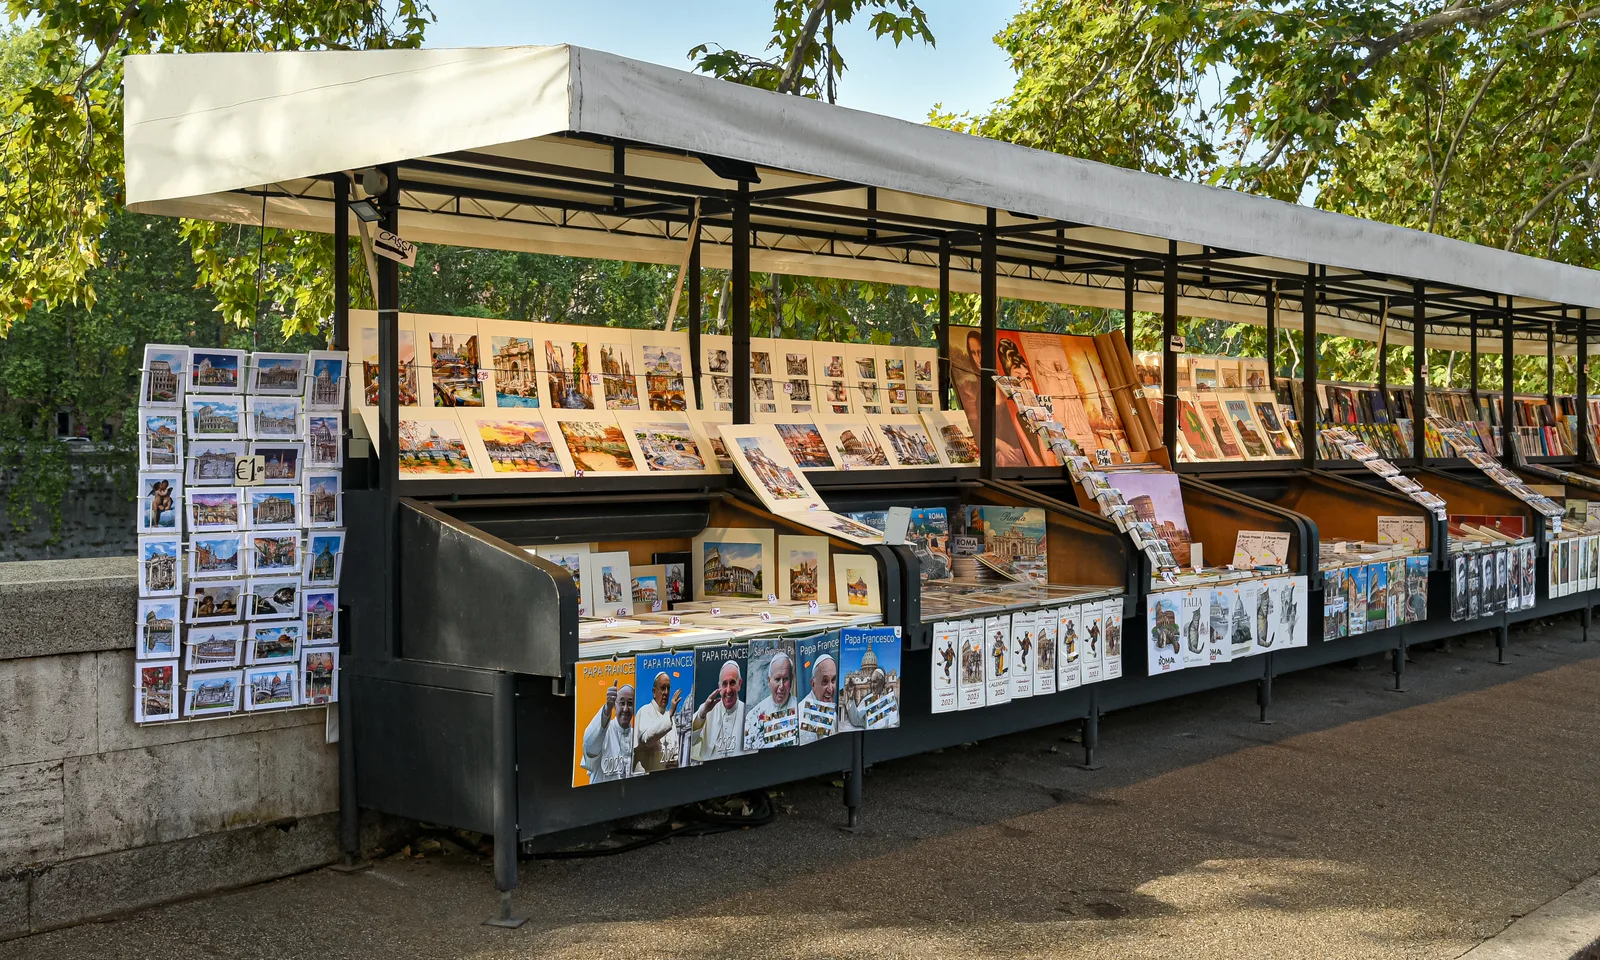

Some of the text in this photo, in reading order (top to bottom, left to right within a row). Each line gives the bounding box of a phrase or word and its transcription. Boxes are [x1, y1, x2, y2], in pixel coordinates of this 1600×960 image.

[379, 231, 414, 253] CASSA
[1229, 402, 1245, 411] ROMA
[236, 457, 264, 482] €1.00
[1000, 511, 1026, 522] Roma
[844, 633, 895, 646] Papa Francesco
[755, 646, 765, 657] San
[787, 645, 795, 655] Pa
[800, 645, 816, 656] Papa
[817, 638, 840, 651] France
[643, 655, 693, 669] PAPA FRANCES
[702, 648, 748, 662] PAPA FRANCES
[583, 662, 635, 679] PAPA FRANCES
[941, 698, 954, 706] 2023
